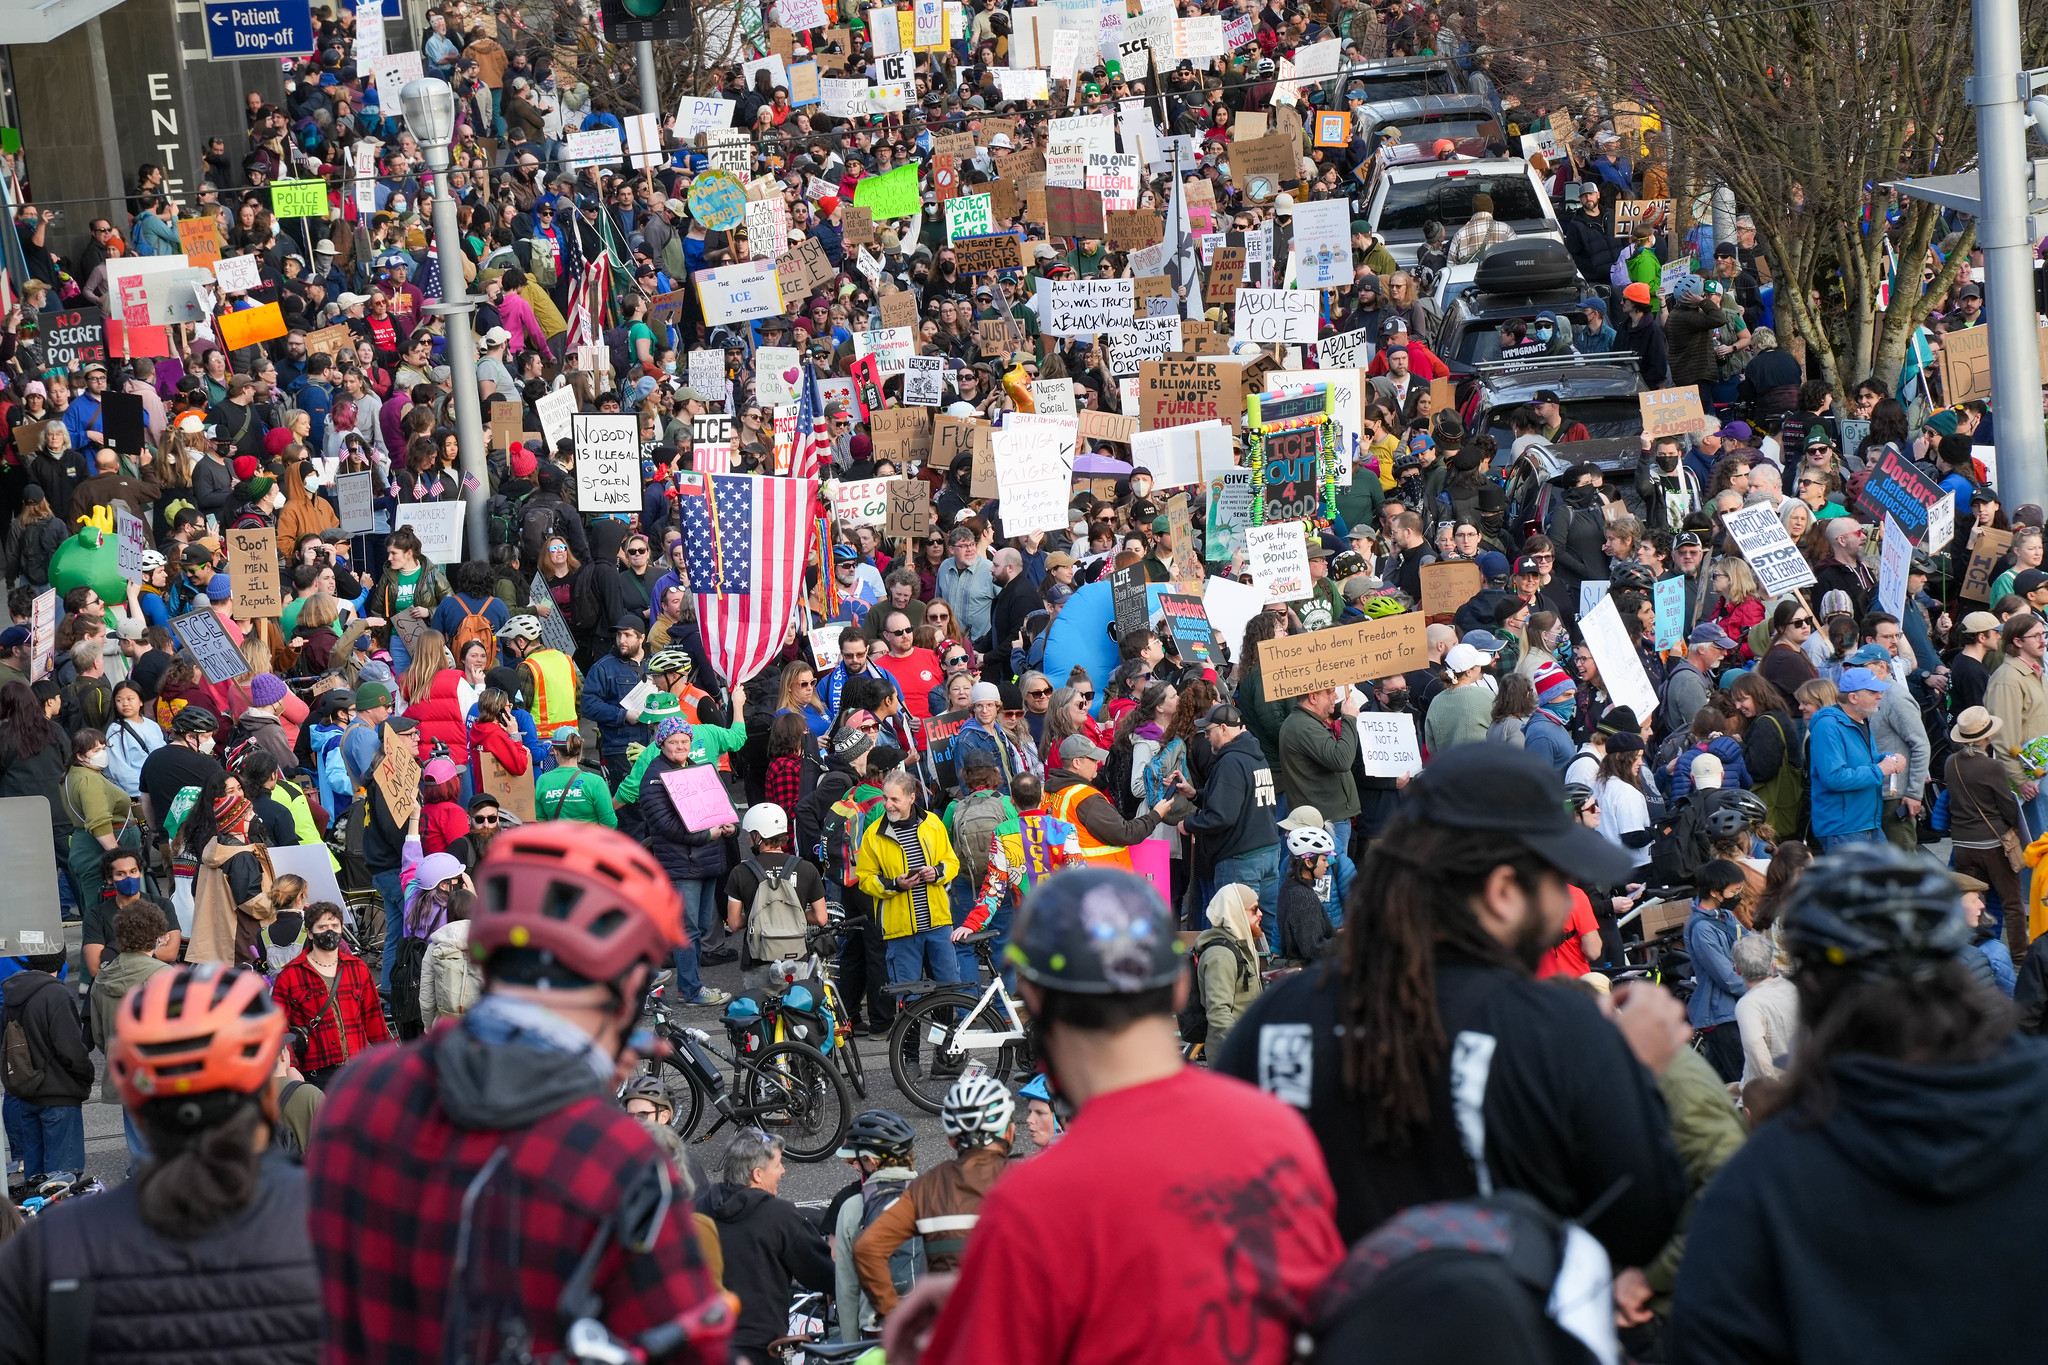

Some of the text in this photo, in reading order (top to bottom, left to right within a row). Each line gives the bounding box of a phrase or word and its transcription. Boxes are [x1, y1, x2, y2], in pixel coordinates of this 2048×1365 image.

[232, 8, 280, 27] Patient
[801, 16, 820, 28] ICE
[918, 15, 938, 29] OUT
[235, 28, 294, 49] Drop-off
[1228, 28, 1255, 48] NOW
[1119, 37, 1148, 57] ICE
[883, 59, 907, 81] ICE
[693, 101, 724, 117] PAT
[719, 137, 749, 151] WHAT
[1049, 146, 1064, 156] ALL
[360, 153, 371, 171] ICE
[720, 151, 747, 163] THE
[934, 155, 953, 168] ICE
[1089, 154, 1136, 166] NO ONE
[719, 163, 750, 175] ACTUAL
[1103, 166, 1119, 177] IS
[1085, 175, 1134, 190] ILLEGAL
[277, 192, 318, 208] POLICE
[720, 190, 744, 204] THE
[1104, 189, 1120, 198] ON
[283, 204, 319, 217] STATE
[945, 195, 989, 215] PROTECT
[703, 203, 746, 230] PEOPLE
[846, 210, 861, 220] FUCK
[954, 211, 987, 226] EACH
[1129, 226, 1159, 238] AMERICA
[1122, 239, 1145, 250] GREAT
[956, 247, 1016, 262] PROTECTS
[1222, 249, 1237, 258] NO
[219, 257, 256, 272] ABOLISH
[958, 258, 1020, 273] FAMILIES
[1215, 260, 1244, 270] FASCISTS
[232, 269, 248, 278] ICE
[741, 275, 765, 284] WRONG
[1219, 272, 1233, 280] NO
[780, 279, 803, 296] ICE
[1051, 281, 1131, 295] ALL HAD TO
[1211, 283, 1236, 296] I.C.E.
[730, 291, 752, 303] ICE
[1073, 297, 1134, 309] WAS TRUST
[1239, 291, 1316, 315] ABOLISH
[740, 306, 769, 315] MELTING
[883, 299, 915, 313] VIOLENCE
[1148, 300, 1168, 315] STOP
[57, 312, 81, 328] NO
[1061, 309, 1135, 331] BLACK WOMAN
[1157, 318, 1178, 328] WERE
[48, 326, 102, 347] SECRET
[861, 330, 896, 345] STOP
[1108, 330, 1172, 348] ALSO JUST
[985, 342, 998, 354] for
[1110, 342, 1171, 362] FOLLOWING
[1321, 330, 1366, 360] ABOLISH
[1502, 343, 1547, 359] IMMIGRANTS
[47, 346, 104, 365] POLICE
[691, 350, 707, 359] THEY
[1331, 350, 1354, 366] ICE
[910, 358, 928, 369] FUCK
[1159, 363, 1217, 377] FEWER
[1036, 383, 1066, 393] Nurses
[1150, 379, 1221, 391] BILLIONAIRES
[1177, 391, 1208, 403] NOT
[1646, 390, 1700, 406] I My
[786, 406, 797, 417] NO
[1040, 401, 1068, 414] Social
[1157, 400, 1218, 417] FÜHRER
[1652, 406, 1687, 424] ICE
[874, 409, 927, 434] Do justly
[1652, 418, 1706, 435] CRUSHED
[576, 417, 633, 444] NOBODY
[693, 418, 731, 443] ICE
[874, 438, 929, 460] Love Mercy
[998, 433, 1054, 457] CHINGA
[1268, 431, 1315, 462] ICE
[577, 448, 589, 460] IS
[595, 450, 638, 460] ILLEGAL
[693, 447, 731, 474] OUT
[1019, 456, 1033, 464] LA
[598, 462, 618, 474] ON
[1001, 463, 1060, 483] MIGRA
[1266, 456, 1315, 486] OUT
[581, 474, 630, 489] STOLEN
[1224, 474, 1249, 484] GIVE
[1880, 451, 1937, 508] Doctors
[594, 489, 631, 504] LANDS
[836, 483, 871, 503] ICE
[1282, 482, 1296, 502] 4
[895, 501, 915, 514] NO
[1865, 479, 1920, 530] democracy
[1881, 476, 1928, 526] defending
[411, 508, 446, 521] WORKERS
[1009, 513, 1066, 531] FUERTES
[1737, 510, 1759, 520] FROM
[890, 513, 924, 532] ICE
[1728, 508, 1778, 538] PORTLAND
[236, 535, 268, 552] Boot
[1249, 526, 1298, 547] Sure Hope
[1739, 527, 1788, 552] MINNEAPOLIS
[1268, 541, 1287, 552] that
[250, 552, 261, 563] the
[1262, 549, 1298, 564] BONUS
[1750, 545, 1797, 568] STOP
[244, 563, 269, 575] MEN
[1257, 564, 1301, 578] was worth
[1758, 556, 1810, 584] ICE TERROR
[1113, 568, 1131, 587] LIFE
[248, 582, 269, 592] ILL
[1268, 581, 1299, 596] SOUL
[1667, 585, 1676, 595] NO
[240, 595, 276, 609] Repute
[1160, 595, 1207, 620] Educators
[1663, 595, 1681, 605] HUMAN
[1666, 607, 1681, 618] BEING
[177, 611, 224, 647] ICE
[1176, 614, 1212, 634] defending
[1173, 625, 1211, 645] democracy
[1265, 624, 1416, 661] Those who deny Freedom to
[194, 643, 212, 656] OUT
[199, 649, 246, 681] PORTLAND
[1272, 642, 1416, 682] others deserve it not for
[1273, 677, 1337, 698] themselves
[1361, 720, 1398, 733] THIS IS
[1375, 735, 1400, 745] NOT A
[1367, 749, 1414, 762] GOOD SIGN
